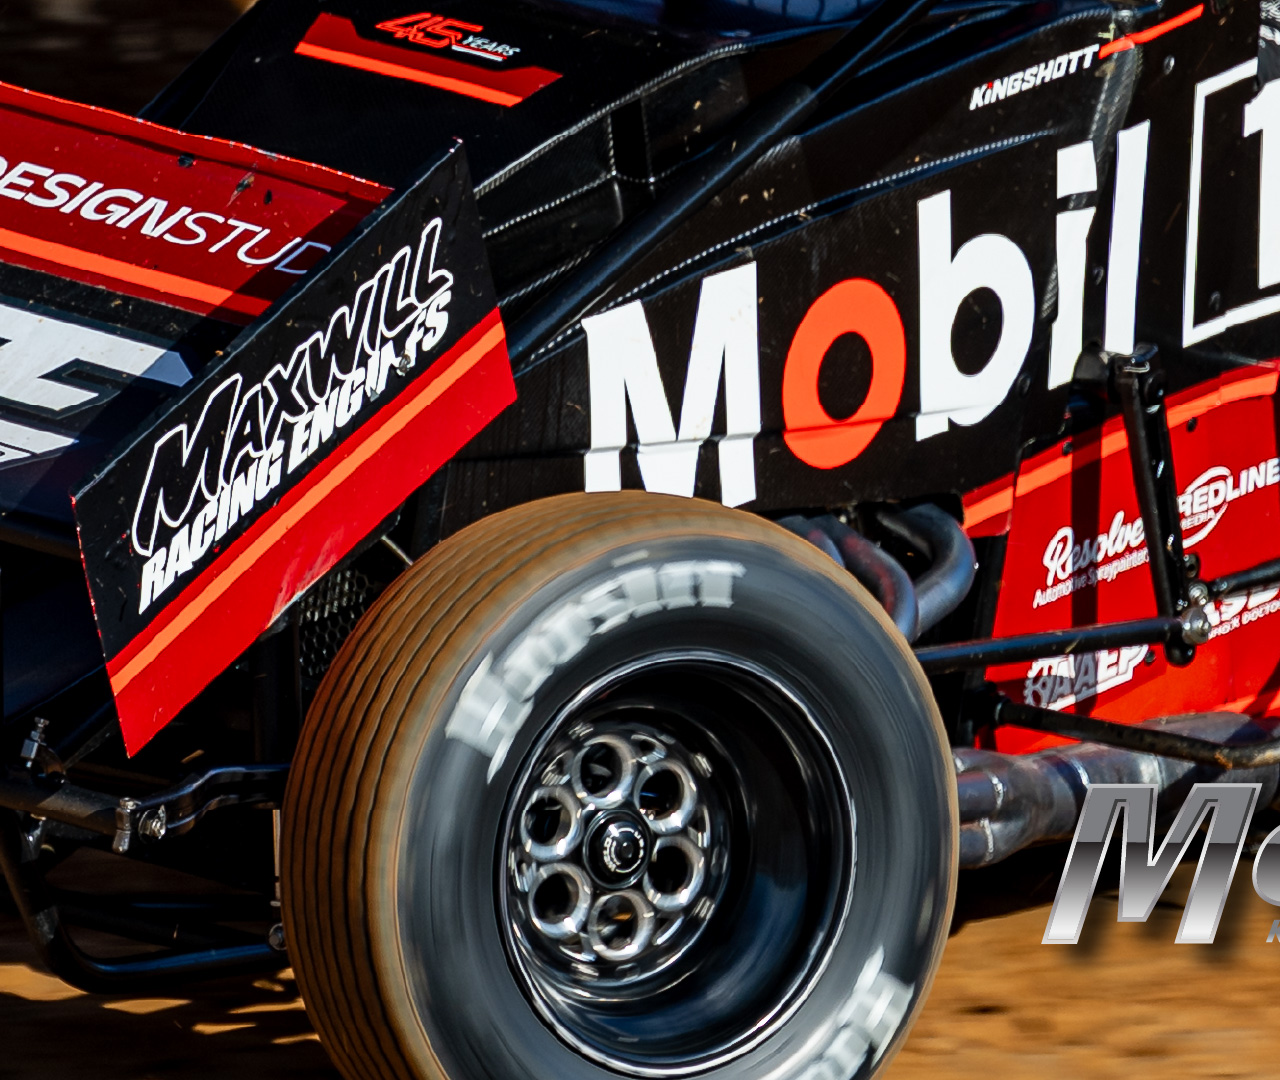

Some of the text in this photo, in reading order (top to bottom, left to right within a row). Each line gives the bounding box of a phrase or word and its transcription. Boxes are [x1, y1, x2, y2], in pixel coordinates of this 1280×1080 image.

[375, 12, 484, 48] 45
[462, 35, 521, 56] YEARS
[583, 120, 1150, 508] Mobil
[139, 439, 283, 615] RACING
[1042, 510, 1145, 587] Resolve
